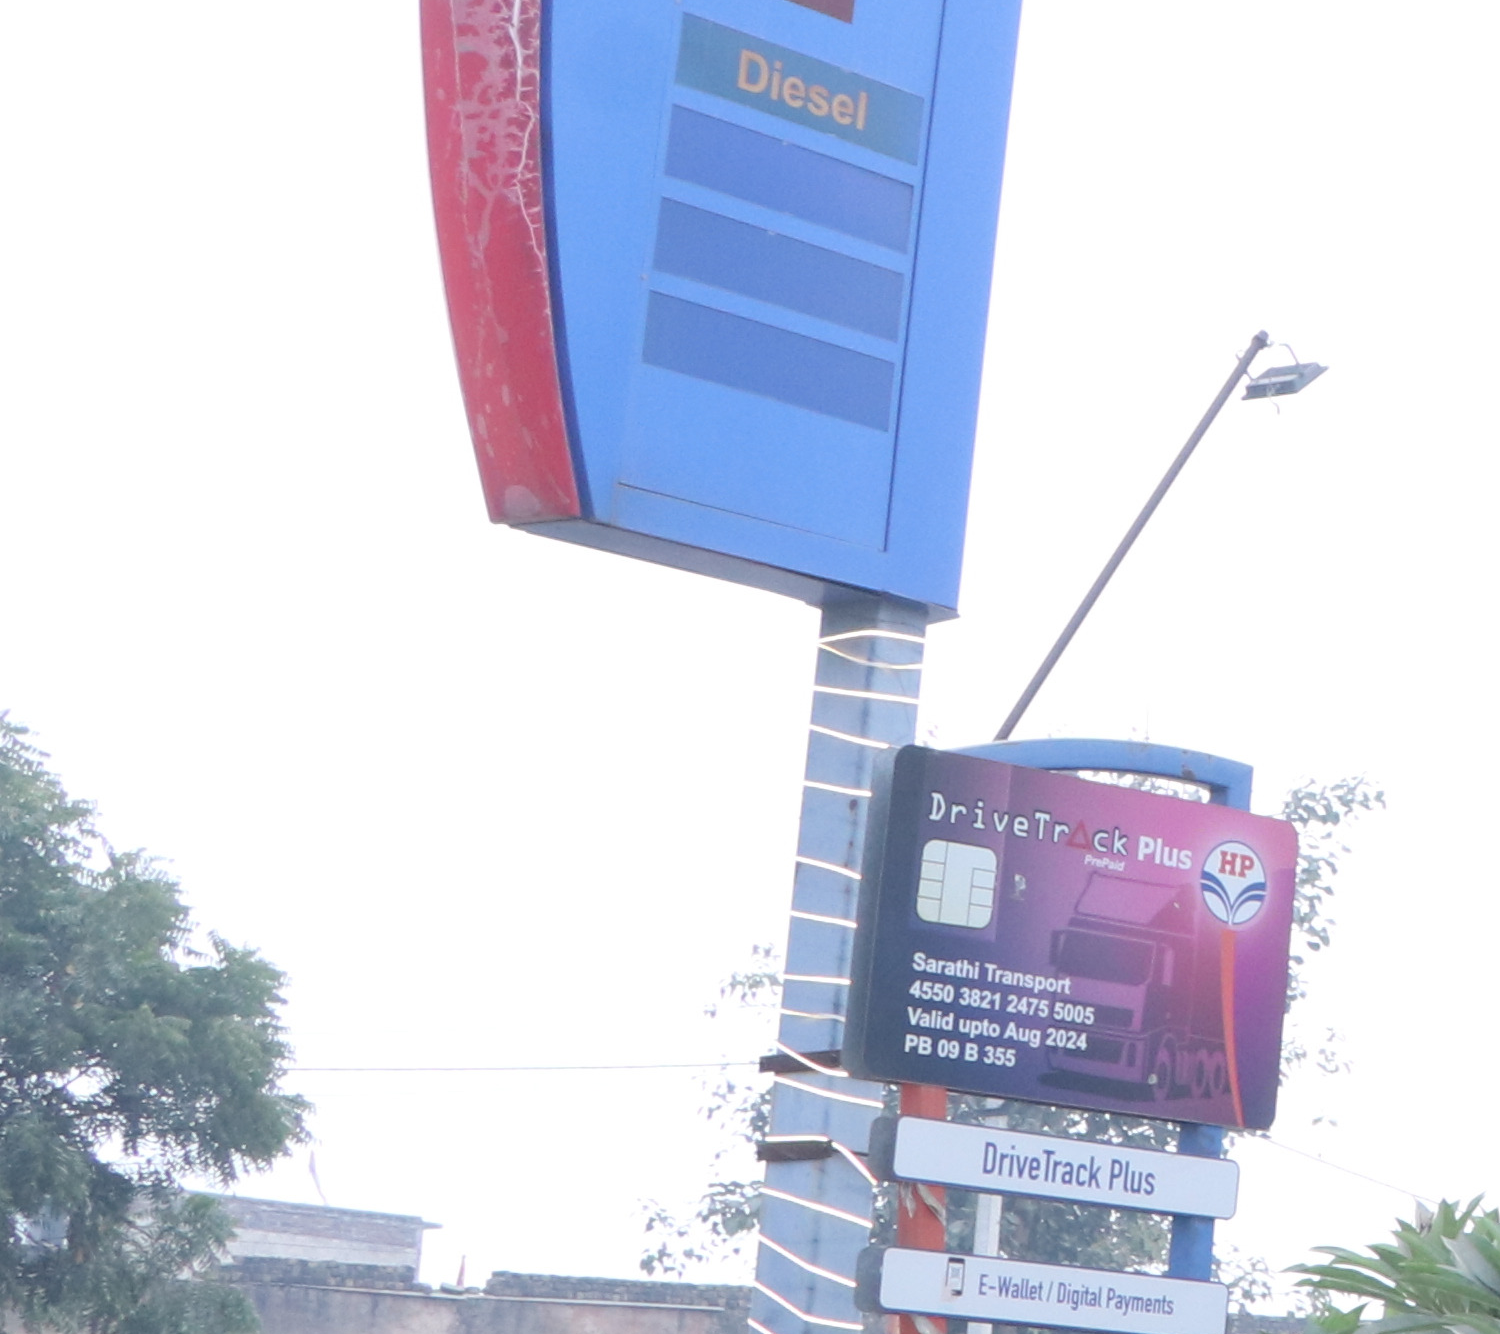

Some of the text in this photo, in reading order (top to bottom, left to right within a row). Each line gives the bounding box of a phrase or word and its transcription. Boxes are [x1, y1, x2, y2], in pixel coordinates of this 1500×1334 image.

[737, 49, 868, 131] Diesel
[1084, 853, 1126, 873] PrePaid
[1137, 835, 1193, 870] Plus
[1217, 850, 1255, 878] HP
[912, 952, 1071, 995] Sarathi Transport
[909, 982, 1095, 1025] 4550 3821 2475 5005
[907, 1006, 1087, 1051] Valid upto Aug 2024
[904, 1035, 1016, 1067] PB 09 B 355
[982, 1142, 1156, 1196] DriveTrack Plus
[978, 1274, 1175, 1316] E-Wallet / Digital Payments
